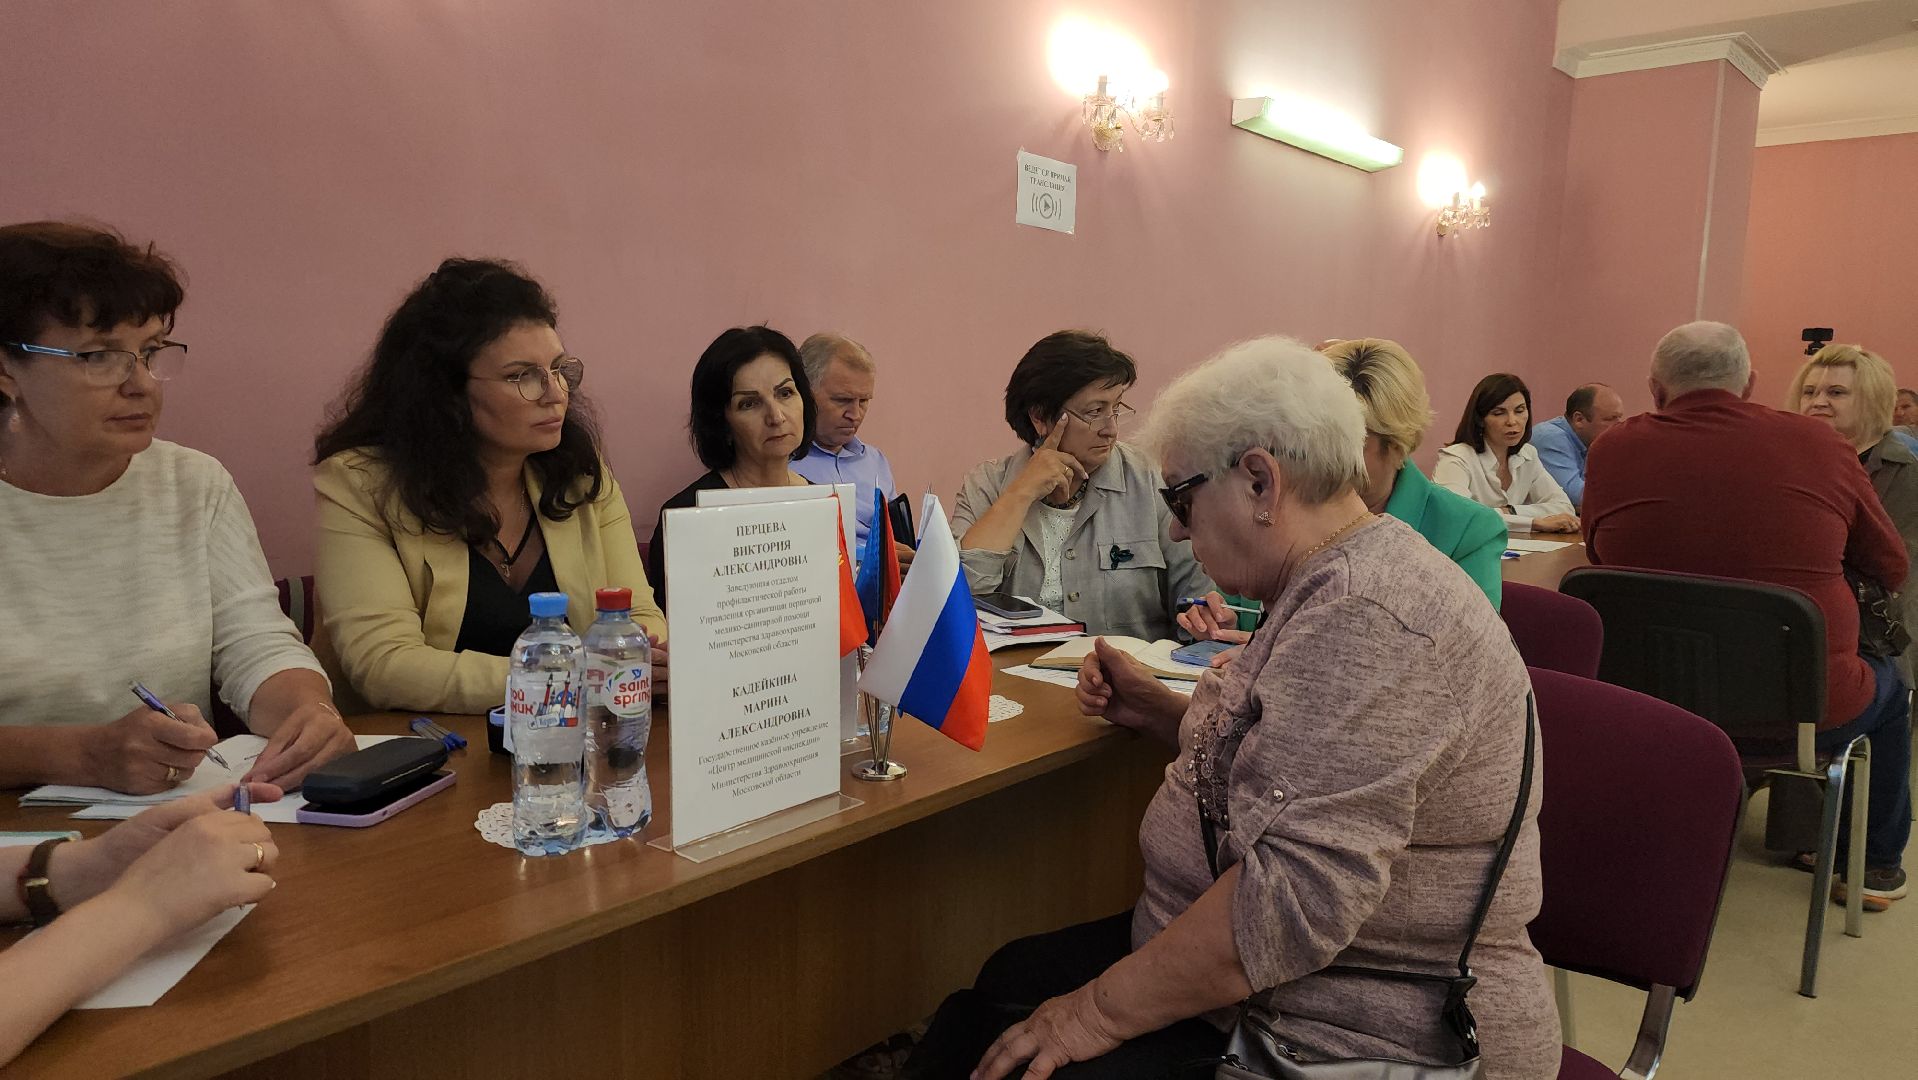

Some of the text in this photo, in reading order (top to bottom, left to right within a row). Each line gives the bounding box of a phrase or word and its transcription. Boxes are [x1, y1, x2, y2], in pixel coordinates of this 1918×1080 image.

[736, 521, 787, 537] ПЕРЦЕВА
[733, 539, 791, 558] ВИКТОРИЯ
[713, 554, 808, 578] АЛЕКСАНДРОВНА
[771, 575, 799, 587] отделом
[717, 586, 807, 610] профилактической работы
[699, 610, 743, 626] Управления
[708, 622, 816, 651] Министерства здравоохранения
[729, 638, 799, 660] Московской области
[619, 676, 649, 693] saint
[732, 672, 798, 698] КАДЕЙКИНА
[743, 694, 789, 715] МАРИНА
[718, 707, 811, 742] АЛЕКСАНДРОВНА
[698, 741, 759, 766] Государственное
[737, 746, 782, 768] медицинской
[711, 769, 762, 791] Министерства
[732, 769, 801, 798] Московской области
